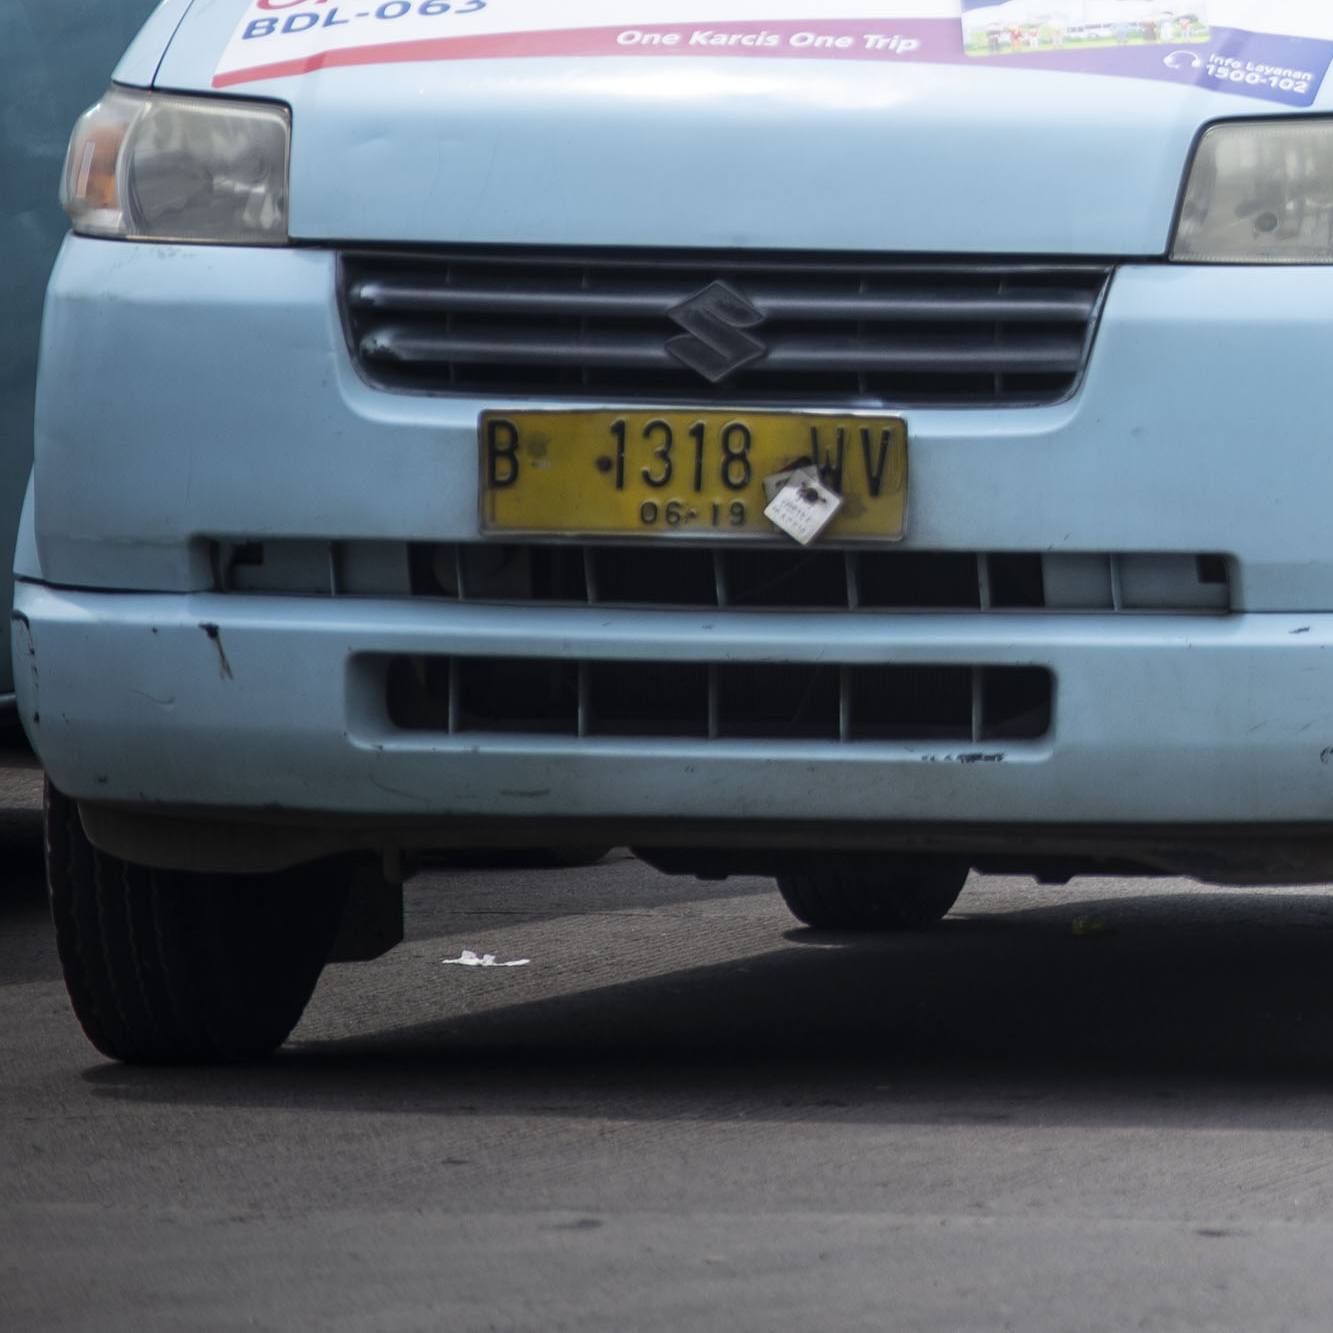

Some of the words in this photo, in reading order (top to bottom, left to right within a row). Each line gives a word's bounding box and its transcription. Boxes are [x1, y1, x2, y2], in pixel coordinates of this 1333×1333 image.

[616, 30, 680, 46] One
[689, 30, 781, 48] Karcis
[789, 32, 853, 49] One
[863, 34, 920, 54] Trip
[1208, 53, 1242, 70] Info
[1206, 64, 1309, 95] 1500-102
[487, 419, 520, 489] B
[609, 419, 753, 493] 1318
